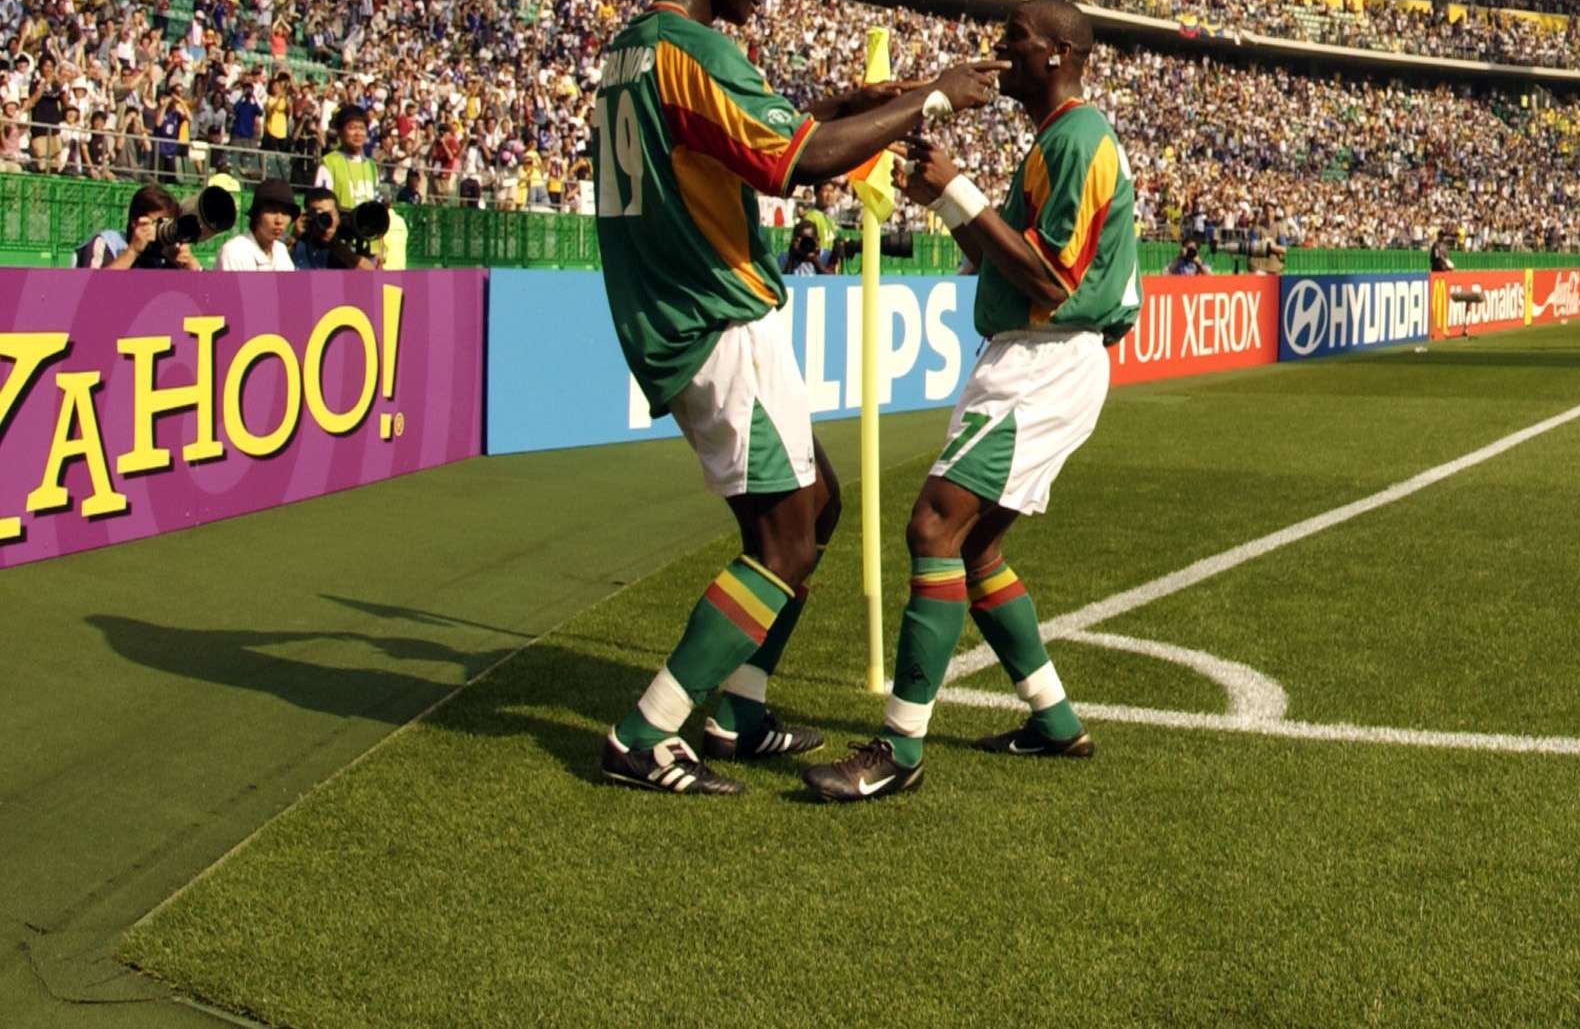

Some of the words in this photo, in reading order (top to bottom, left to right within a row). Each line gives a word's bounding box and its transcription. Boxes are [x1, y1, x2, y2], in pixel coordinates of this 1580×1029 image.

[591, 88, 644, 216] 19
[1180, 290, 1262, 359] XEROX
[1328, 280, 1429, 348] HYUNDAI
